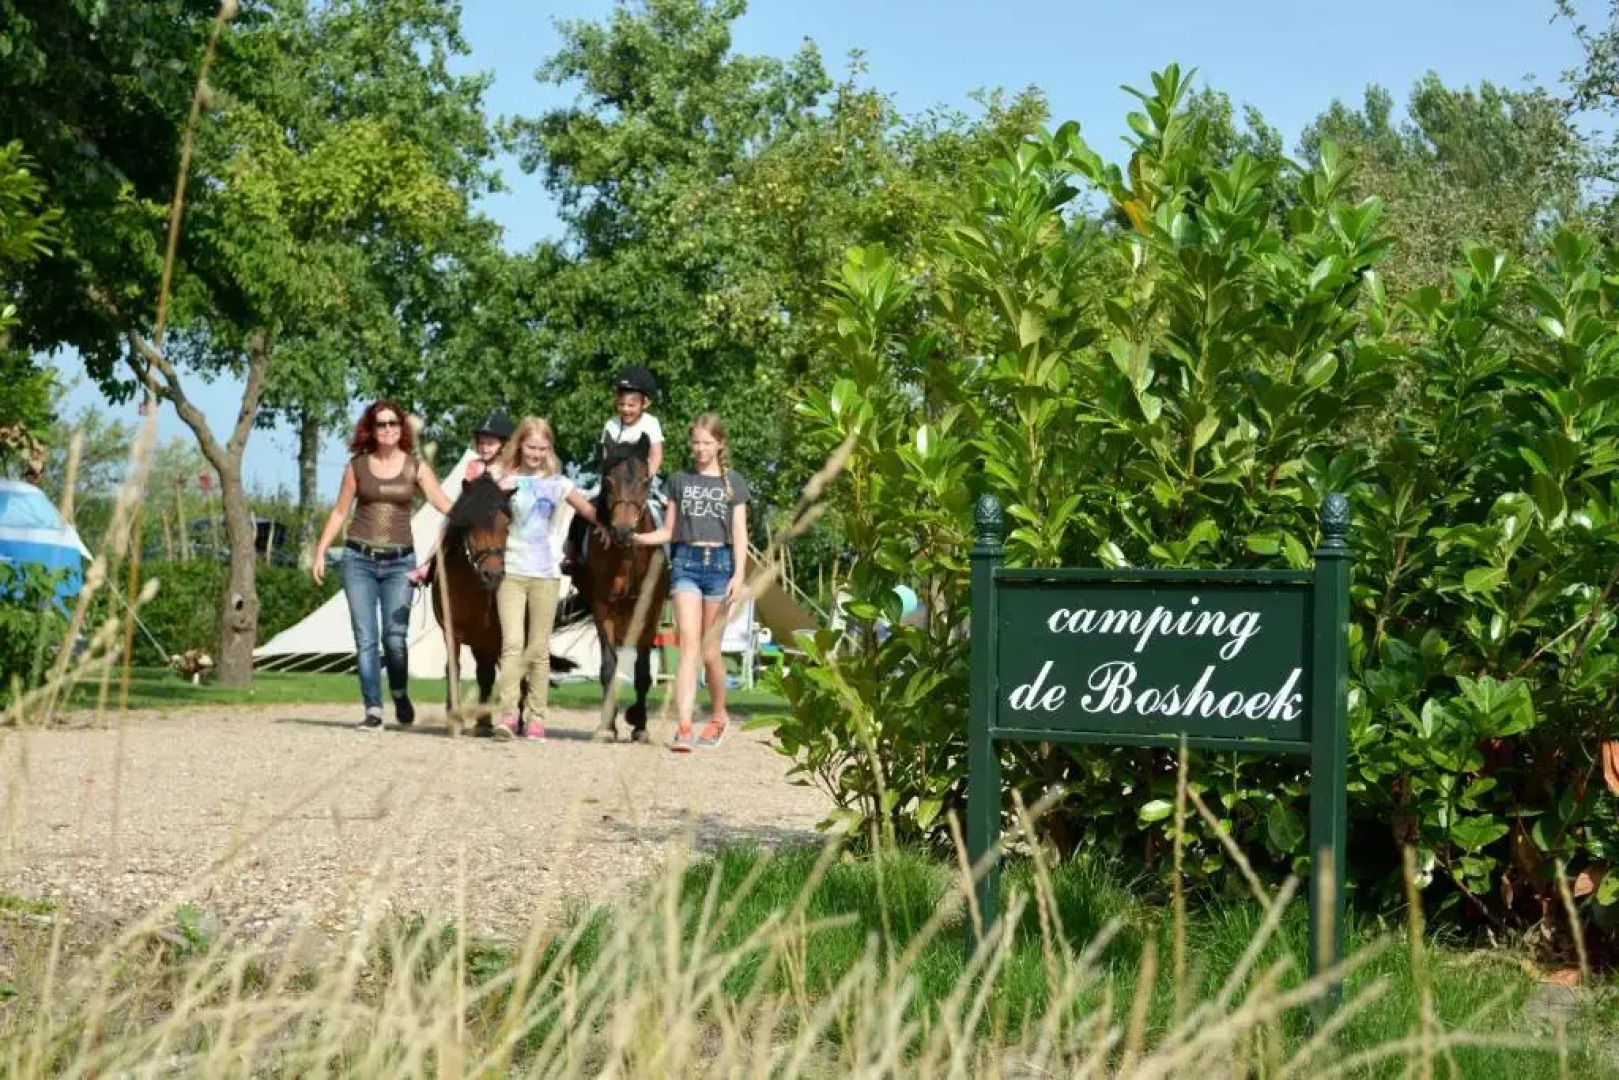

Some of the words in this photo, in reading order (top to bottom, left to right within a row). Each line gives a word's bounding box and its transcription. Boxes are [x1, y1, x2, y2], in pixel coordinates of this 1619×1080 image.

[1047, 596, 1262, 660] camping
[1008, 660, 1067, 711] de
[1081, 660, 1304, 721] Boshoek
